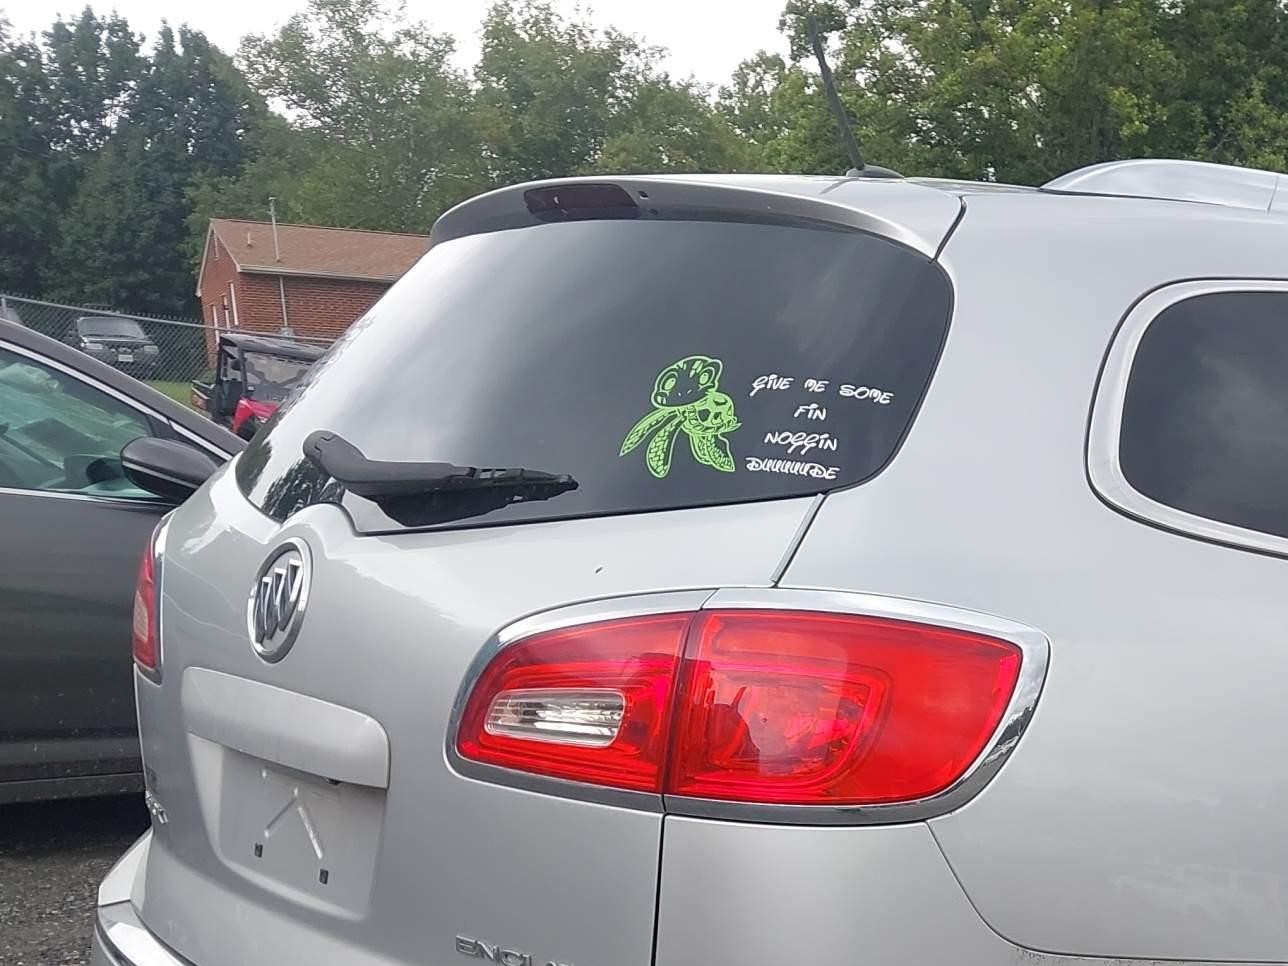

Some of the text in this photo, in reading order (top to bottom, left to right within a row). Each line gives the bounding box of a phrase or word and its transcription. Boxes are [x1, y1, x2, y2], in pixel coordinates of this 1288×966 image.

[750, 374, 894, 404] GIVE ME SOME
[794, 403, 827, 421] FIN
[764, 431, 838, 455] NOGGIN
